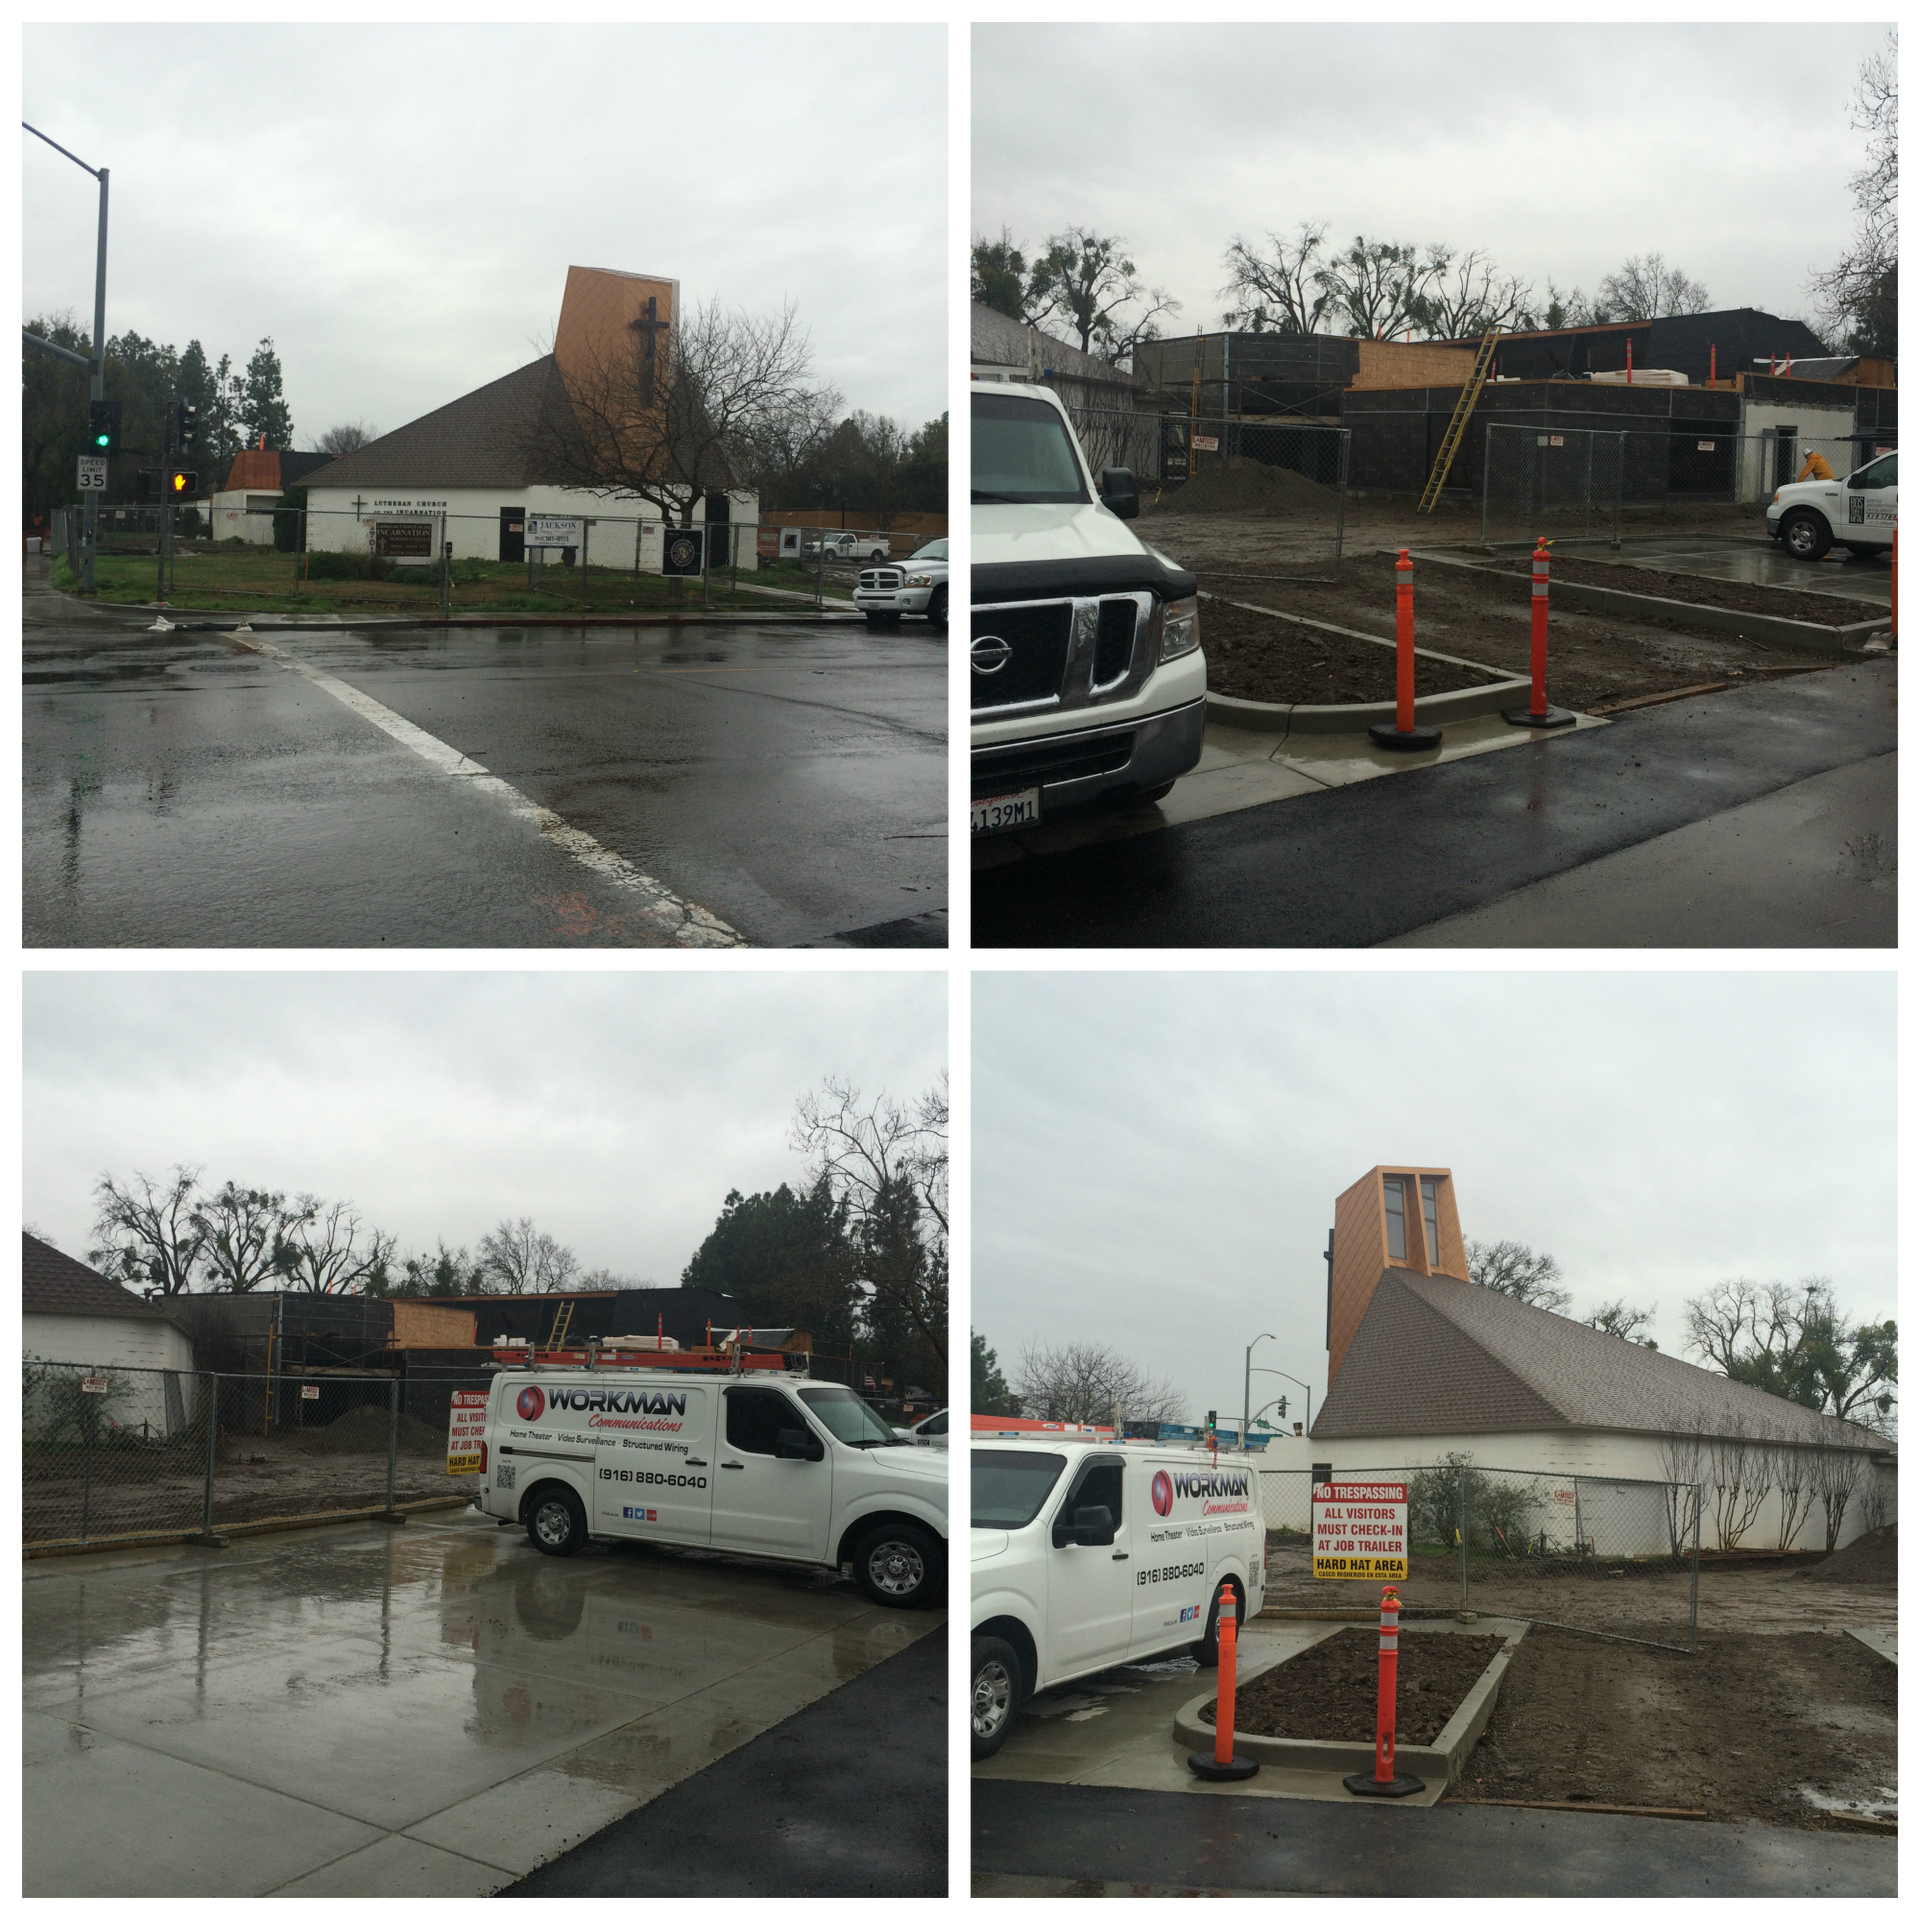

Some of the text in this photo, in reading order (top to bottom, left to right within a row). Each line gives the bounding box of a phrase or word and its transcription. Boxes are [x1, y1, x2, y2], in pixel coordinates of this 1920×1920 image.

[80, 474, 104, 487] 35
[1850, 496, 1863, 508] BOS
[540, 521, 576, 529] JACKSON
[969, 650, 1010, 660] NISSAN
[453, 1394, 463, 1405] NO
[549, 1389, 687, 1416] WORKMAN
[457, 1413, 467, 1423] ALL
[588, 1413, 684, 1432] Communications
[452, 1427, 469, 1437] MUST
[451, 1441, 459, 1451] AT
[460, 1440, 472, 1450] JOB
[510, 1429, 689, 1456] Home Theater Video Surveillance Structured Wiring
[449, 1456, 480, 1467] HARD HAT
[600, 1468, 707, 1489] (916) 880-6040
[1174, 1473, 1248, 1498] WORKMAN
[1317, 1486, 1403, 1500] NO TRESPASSING
[1203, 1499, 1248, 1516] Communications
[1324, 1508, 1395, 1520] ALL VISITORS
[1151, 1532, 1165, 1542] Home
[1165, 1530, 1183, 1540] Theater
[1185, 1527, 1198, 1537] Video
[1317, 1524, 1403, 1536] MUST CHECK-IN
[1318, 1540, 1403, 1552] AT JOB TRAILER
[1317, 1559, 1403, 1571] HARD HAT AREA
[1137, 1562, 1204, 1586] (916) 880-6040
